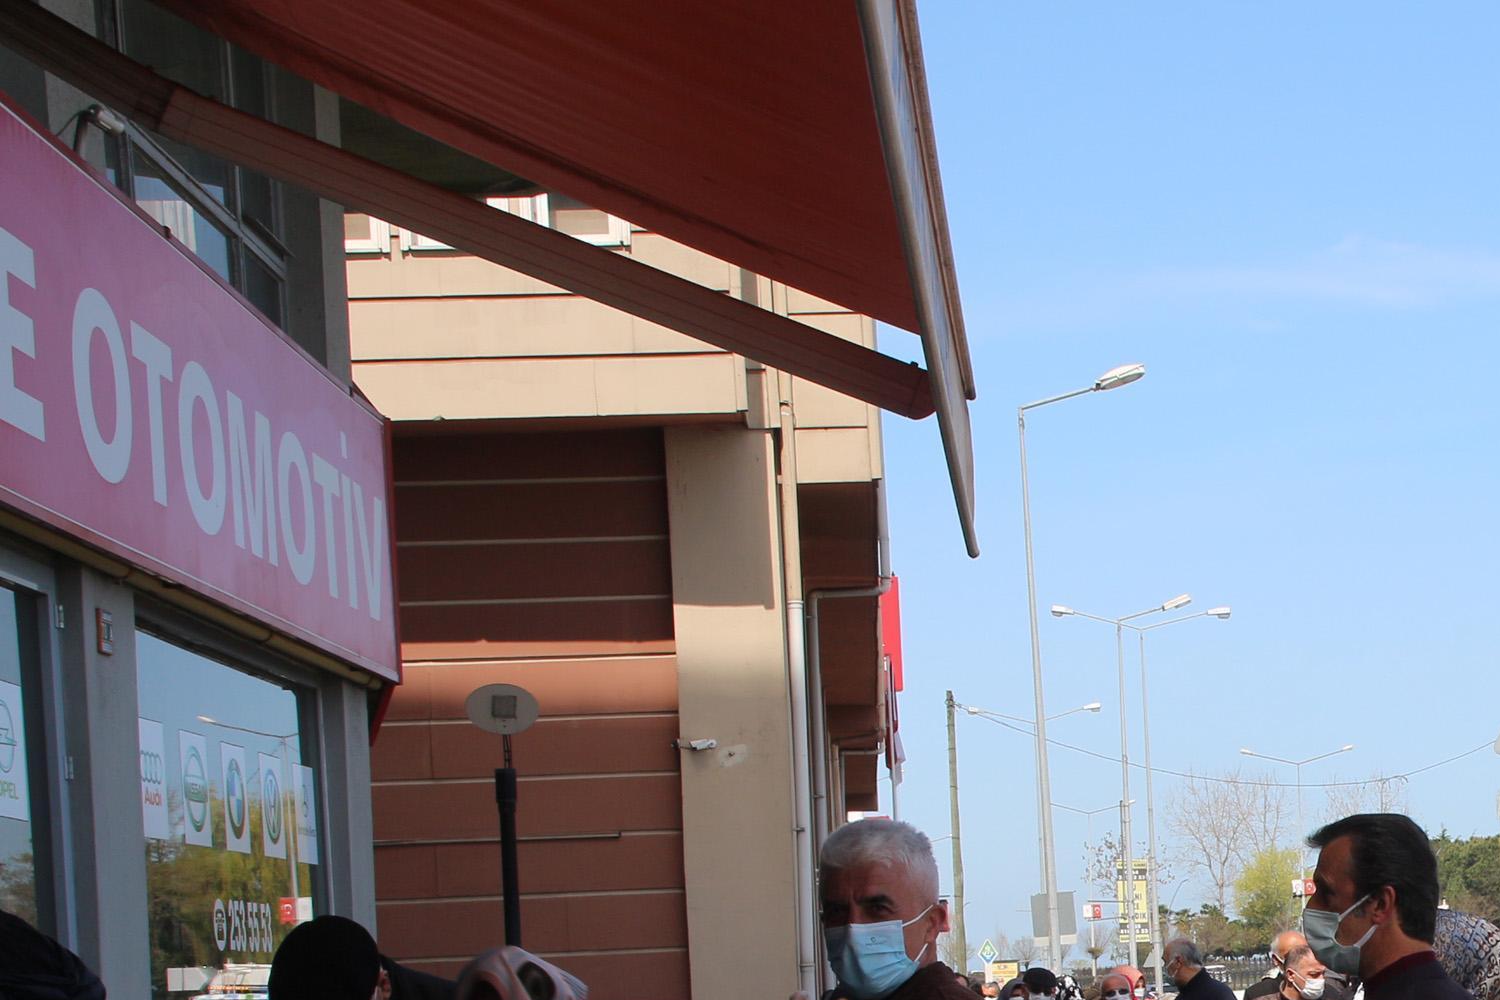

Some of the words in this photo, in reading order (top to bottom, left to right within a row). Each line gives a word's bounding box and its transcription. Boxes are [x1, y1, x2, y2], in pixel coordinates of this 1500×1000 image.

[72, 286, 382, 621] OTOMOTİV
[228, 899, 247, 953] 253
[247, 902, 260, 953] 55
[260, 903, 273, 953] 53
